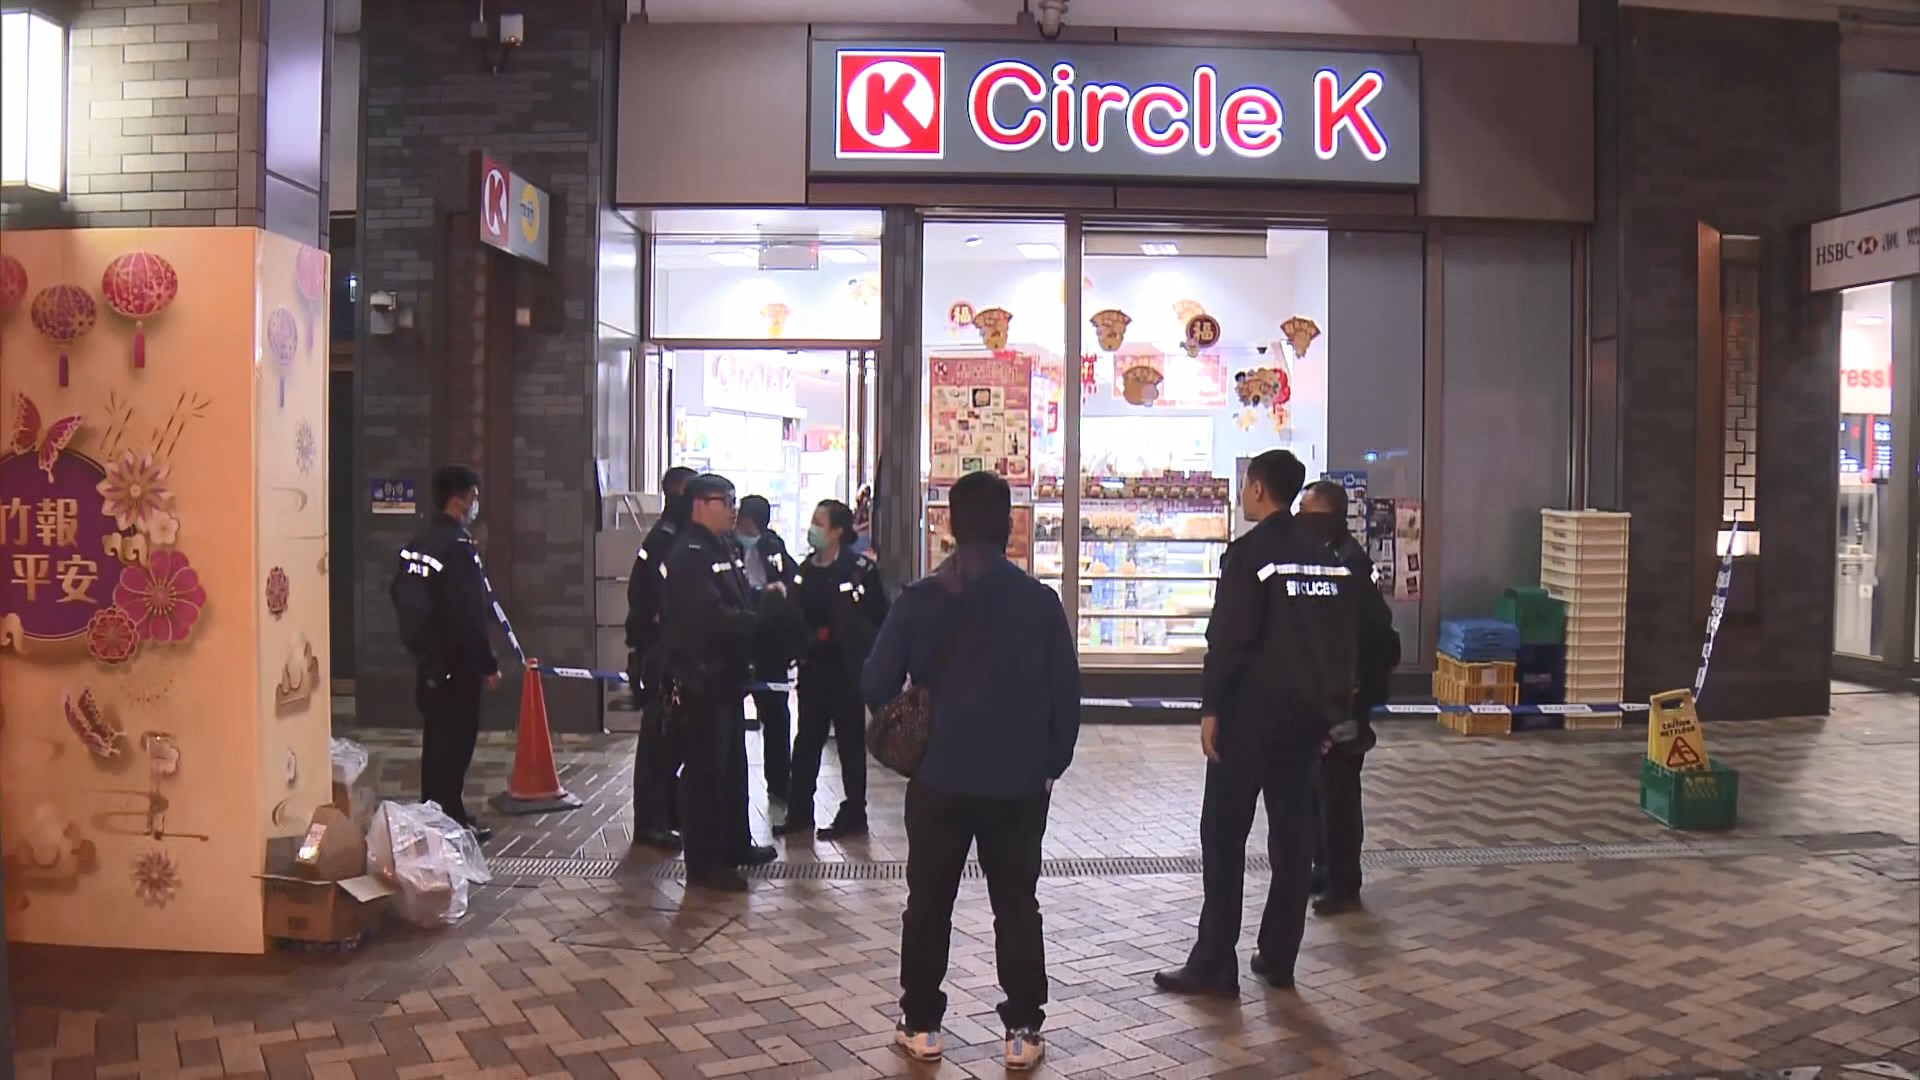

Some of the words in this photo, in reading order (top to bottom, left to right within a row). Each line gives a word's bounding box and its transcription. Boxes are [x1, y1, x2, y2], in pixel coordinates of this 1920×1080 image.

[862, 70, 929, 140] K
[969, 60, 1284, 156] Circle
[1314, 70, 1387, 160] K
[488, 173, 506, 232] K
[1815, 240, 1855, 266] HSBC
[1192, 320, 1214, 341] 福
[0, 497, 78, 547] 竹報
[11, 554, 98, 603] 平安
